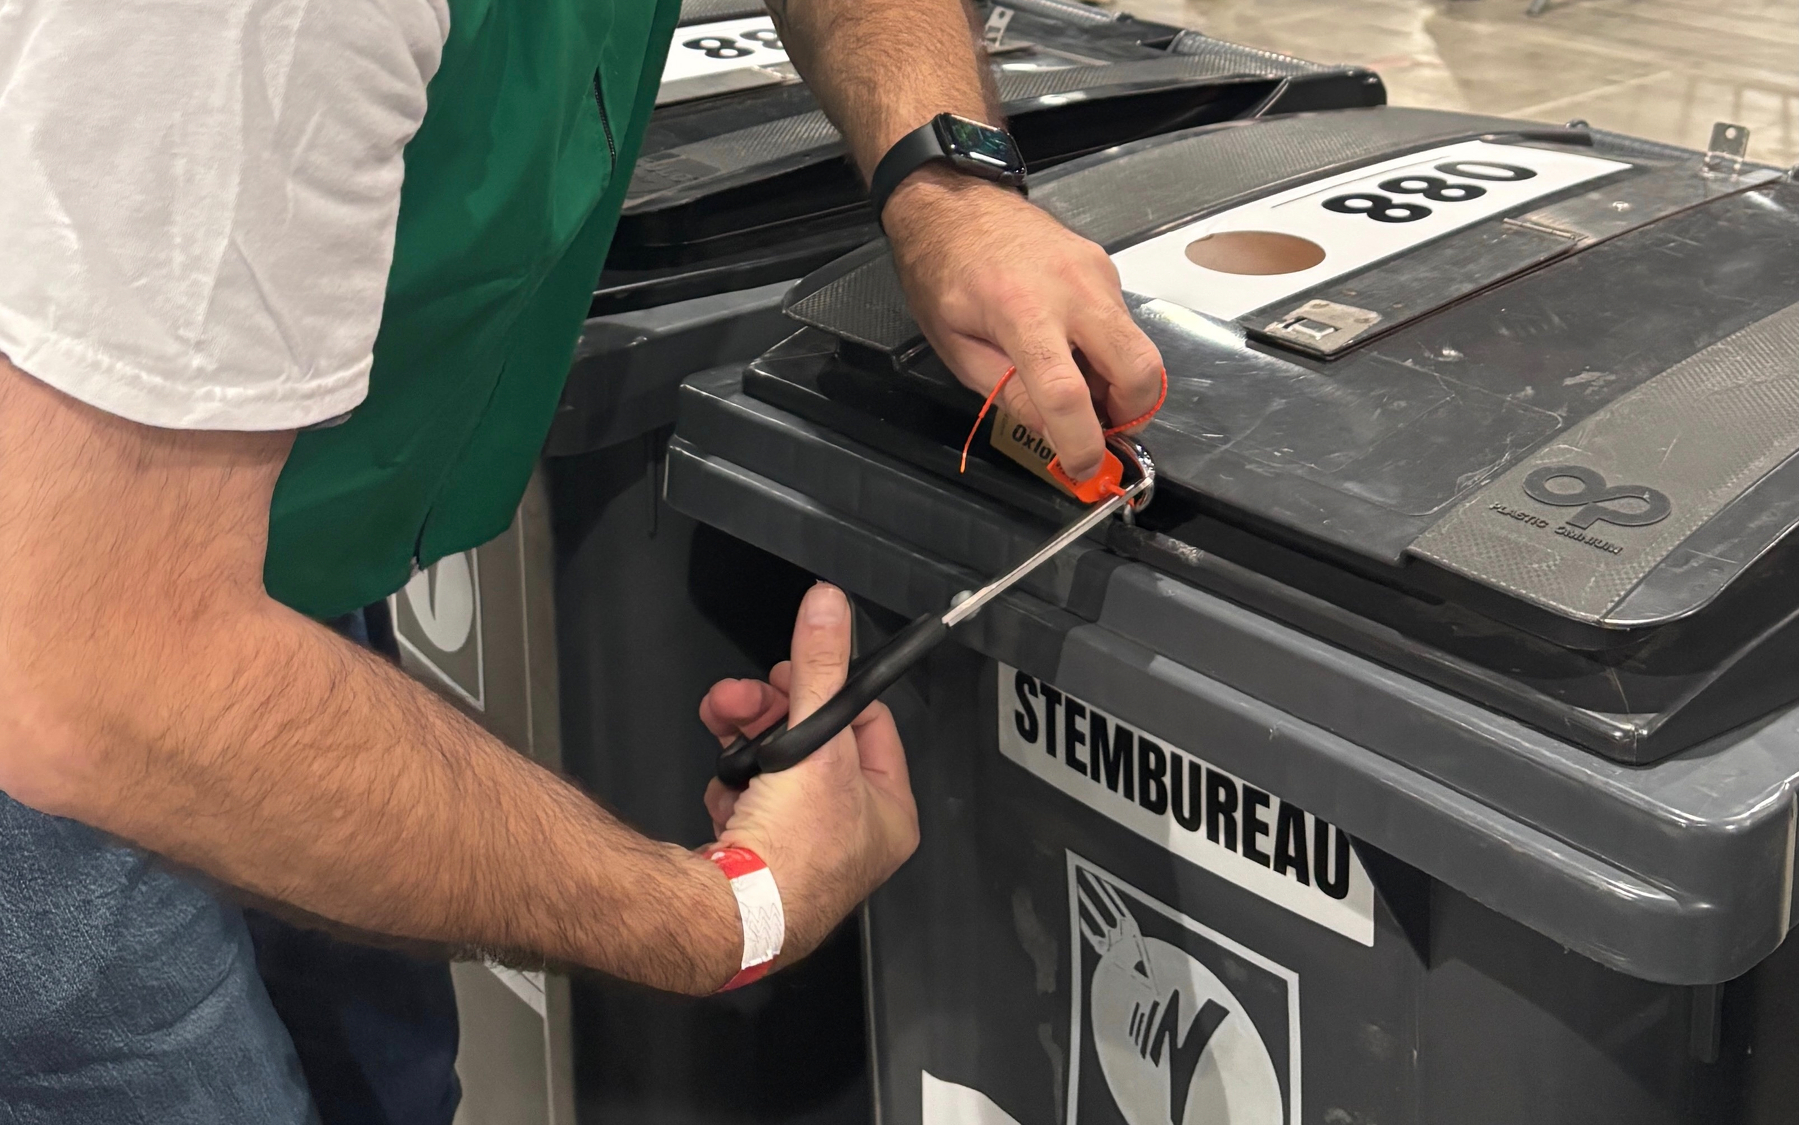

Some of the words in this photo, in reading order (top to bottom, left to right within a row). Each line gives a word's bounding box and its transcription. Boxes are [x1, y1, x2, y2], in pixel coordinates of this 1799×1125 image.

[1489, 501, 1549, 529] PLASTIC
[1554, 526, 1624, 556] OMNIUM
[1014, 669, 1351, 901] STEMBUREAU
